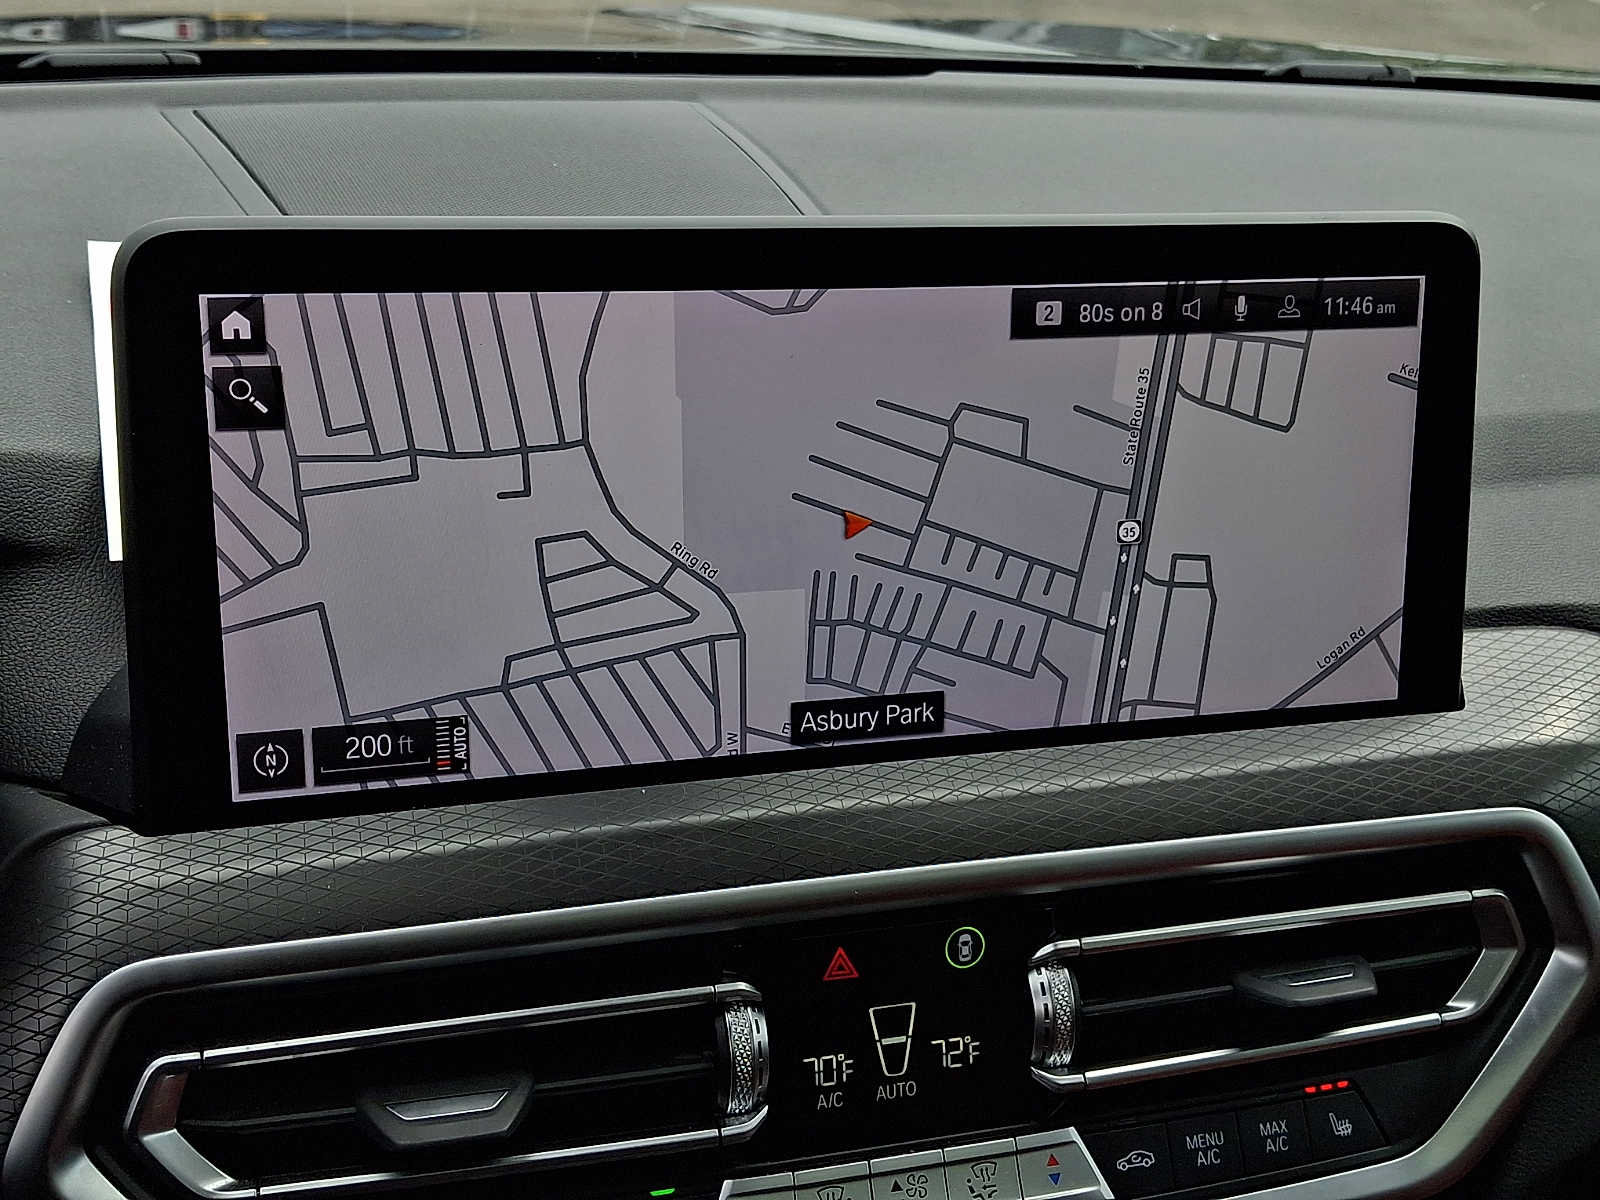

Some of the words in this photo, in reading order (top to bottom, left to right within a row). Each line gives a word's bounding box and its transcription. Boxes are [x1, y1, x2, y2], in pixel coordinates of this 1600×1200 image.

[1044, 305, 1054, 321] 2
[1079, 303, 1114, 323] 80s
[1120, 307, 1145, 322] on
[1151, 302, 1163, 320] 8
[1323, 296, 1373, 316] 11:46
[1376, 303, 1396, 314] am
[1137, 367, 1150, 384] 35
[1130, 387, 1147, 427] Route
[1123, 430, 1139, 465] State
[1122, 526, 1136, 538] 35
[671, 541, 699, 568] Ring
[699, 561, 719, 579] Rd
[1316, 640, 1350, 669] Logan
[1349, 625, 1367, 643] Rd
[801, 709, 879, 732] Asbury
[886, 702, 936, 726] Park
[345, 733, 392, 760] 200
[397, 735, 414, 754] ft
[453, 726, 467, 760] AUTO
[265, 754, 277, 767] N
[931, 1035, 980, 1068] 72°F
[803, 1053, 853, 1087] 70°F
[817, 1091, 843, 1110] A/C
[876, 1081, 917, 1102] AUTO
[1259, 1119, 1288, 1137] MAX
[1186, 1131, 1224, 1150] MENU
[1265, 1135, 1289, 1153] A/C
[1197, 1149, 1221, 1167] A/C
